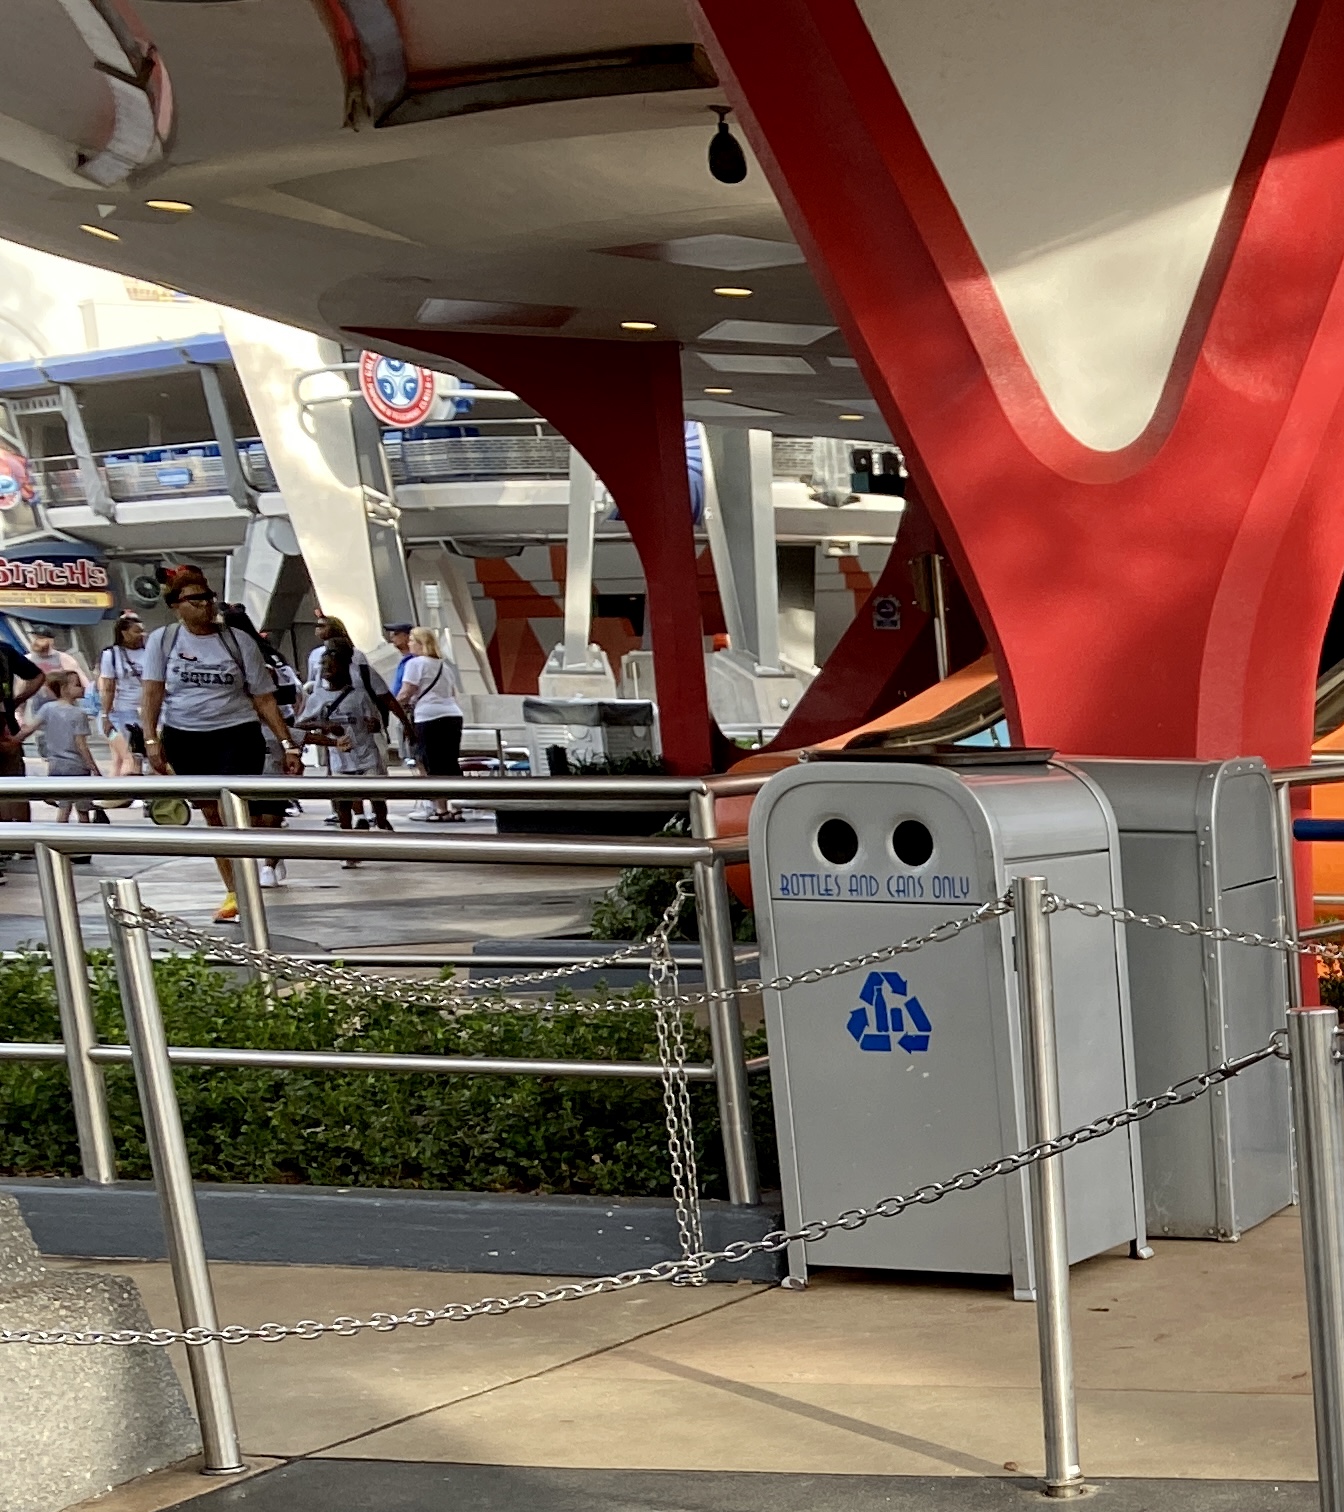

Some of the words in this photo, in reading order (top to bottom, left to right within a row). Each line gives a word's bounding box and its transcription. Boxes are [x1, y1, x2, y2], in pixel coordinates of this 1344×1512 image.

[180, 671, 235, 687] SQUAD
[779, 873, 841, 897] BOTTLES
[848, 874, 879, 897] AND
[887, 875, 924, 898] CANS
[932, 875, 970, 899] ONLY
